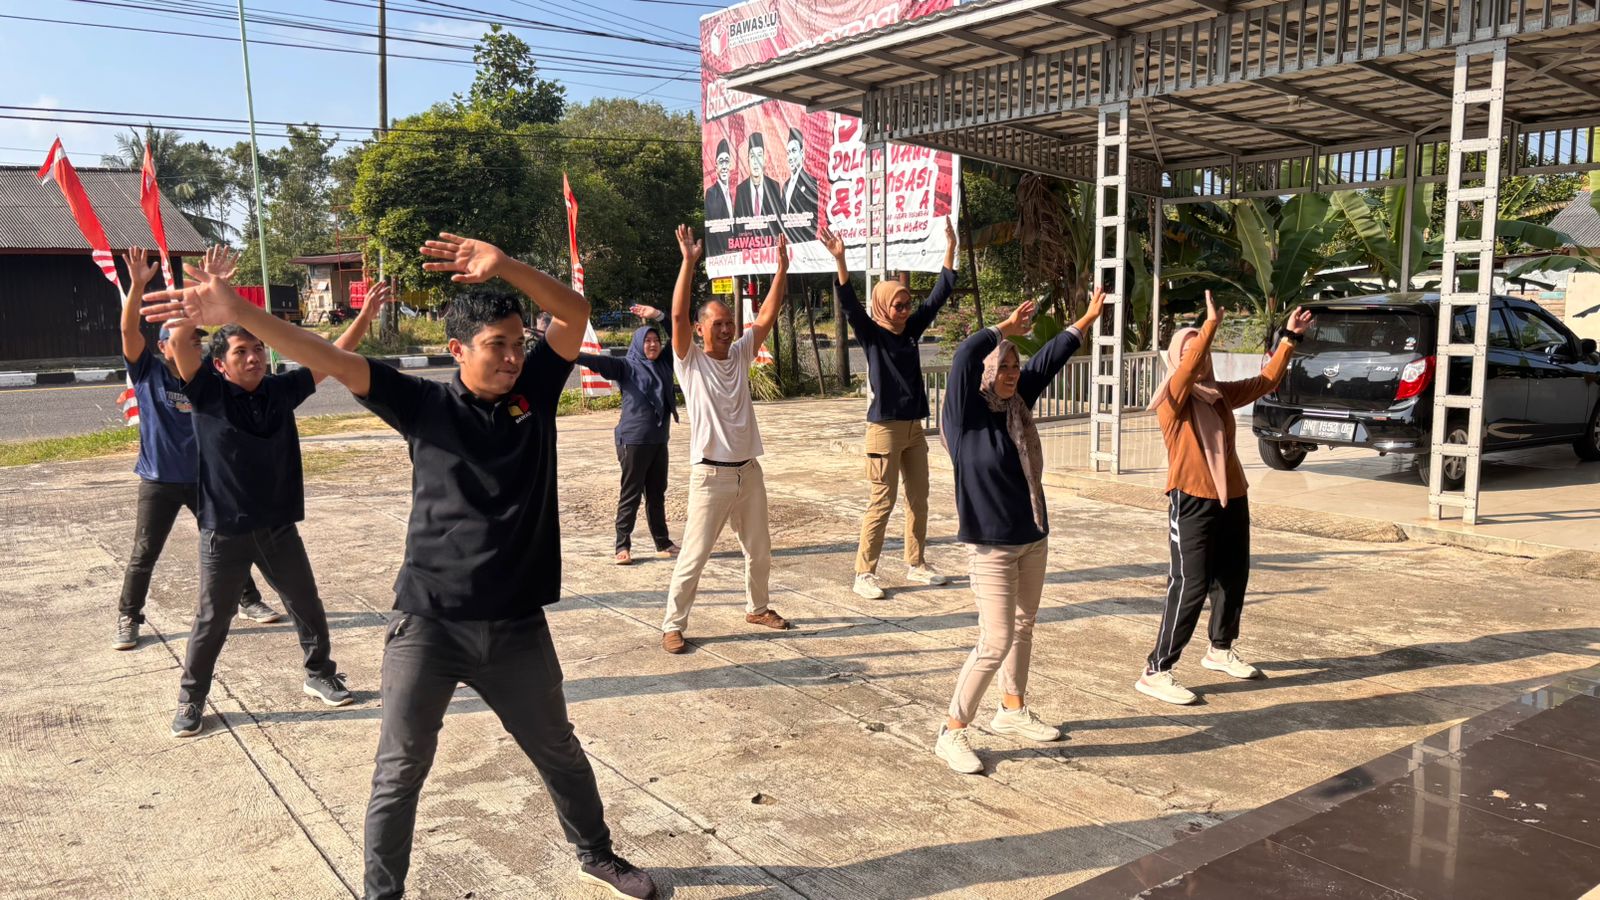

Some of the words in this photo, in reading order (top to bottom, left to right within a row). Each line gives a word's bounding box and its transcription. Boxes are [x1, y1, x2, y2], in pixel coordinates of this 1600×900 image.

[729, 12, 777, 38] BAWASLU
[728, 235, 772, 250] BAWASLU
[708, 254, 737, 267] RAKYAT
[741, 246, 794, 265] PEMI
